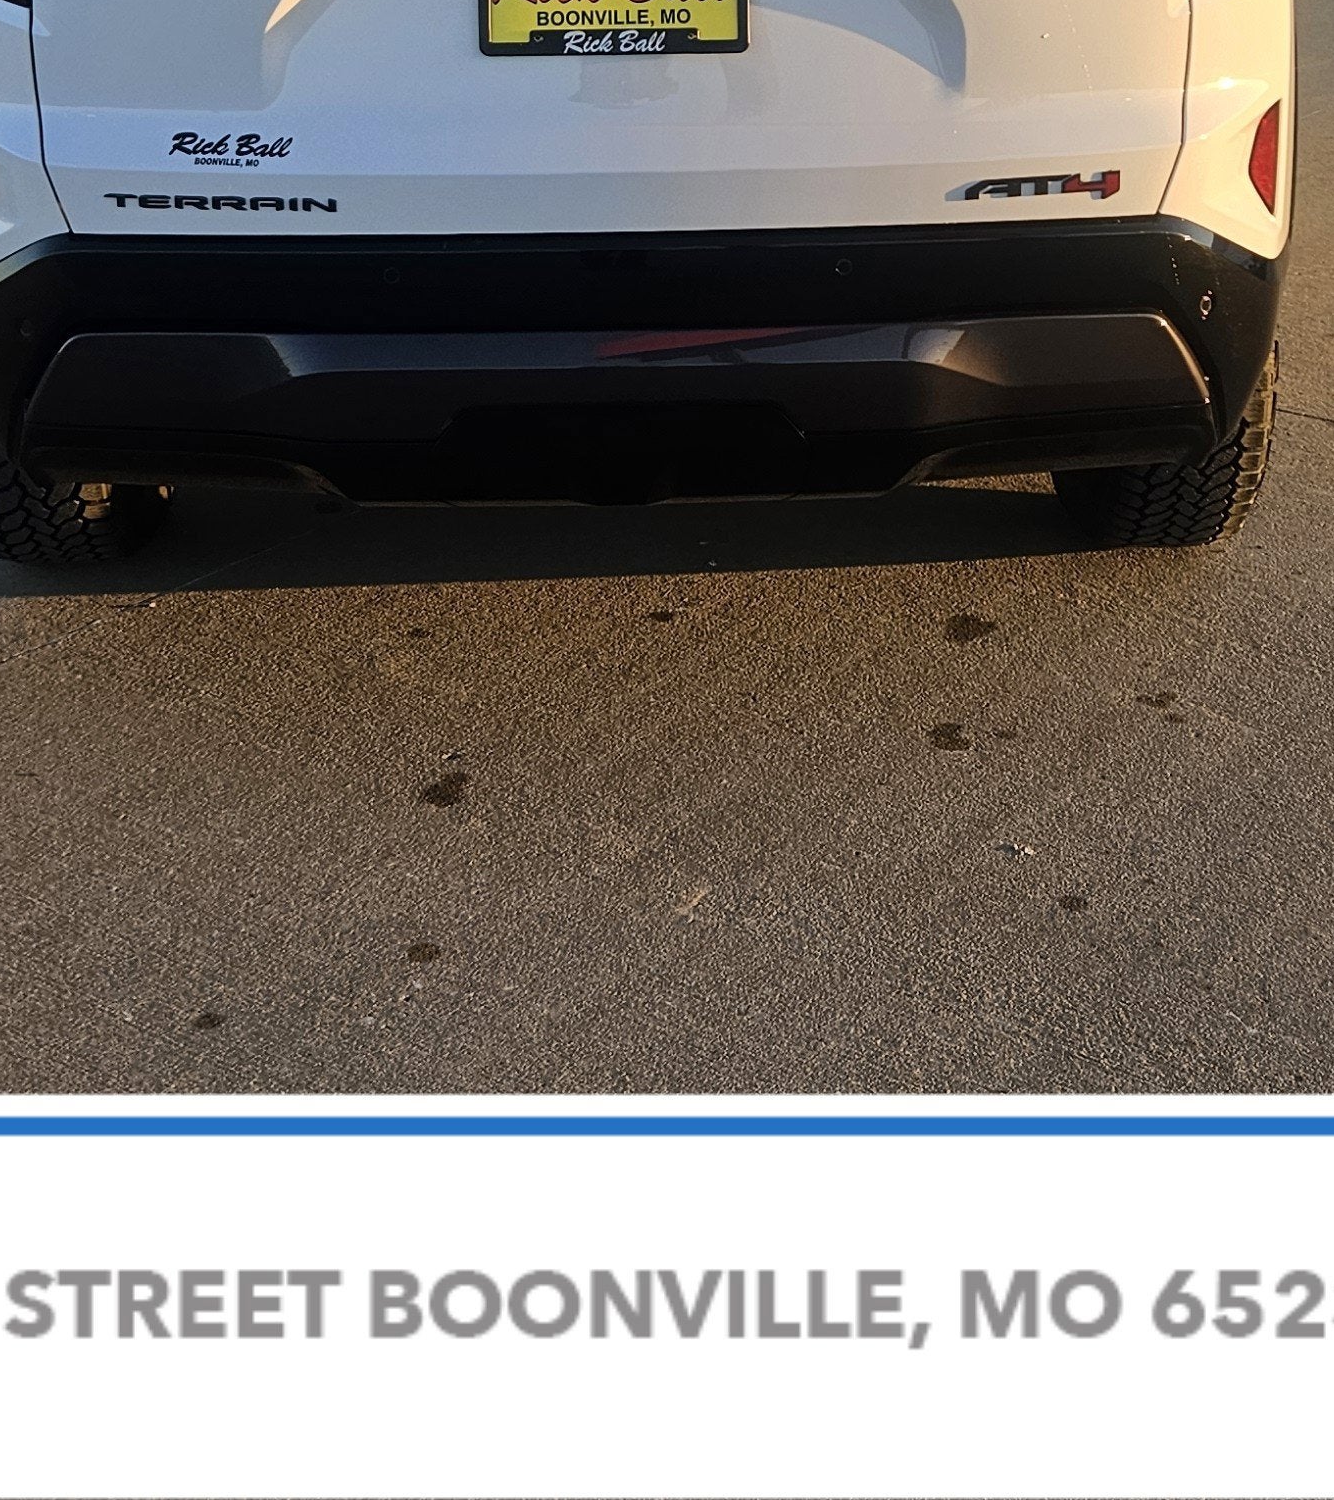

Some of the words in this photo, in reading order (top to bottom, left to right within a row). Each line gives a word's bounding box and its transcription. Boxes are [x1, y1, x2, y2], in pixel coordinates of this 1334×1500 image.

[536, 10, 655, 28] BOONVILLE,
[660, 9, 691, 24] MO
[563, 31, 614, 54] Rick
[618, 30, 666, 53] Ball
[168, 131, 231, 157] Rick
[235, 133, 294, 158] Ball
[194, 157, 243, 168] BOONVILLE,
[245, 159, 259, 168] MO
[944, 169, 1121, 202] AT4
[103, 192, 338, 213] TERRAIN
